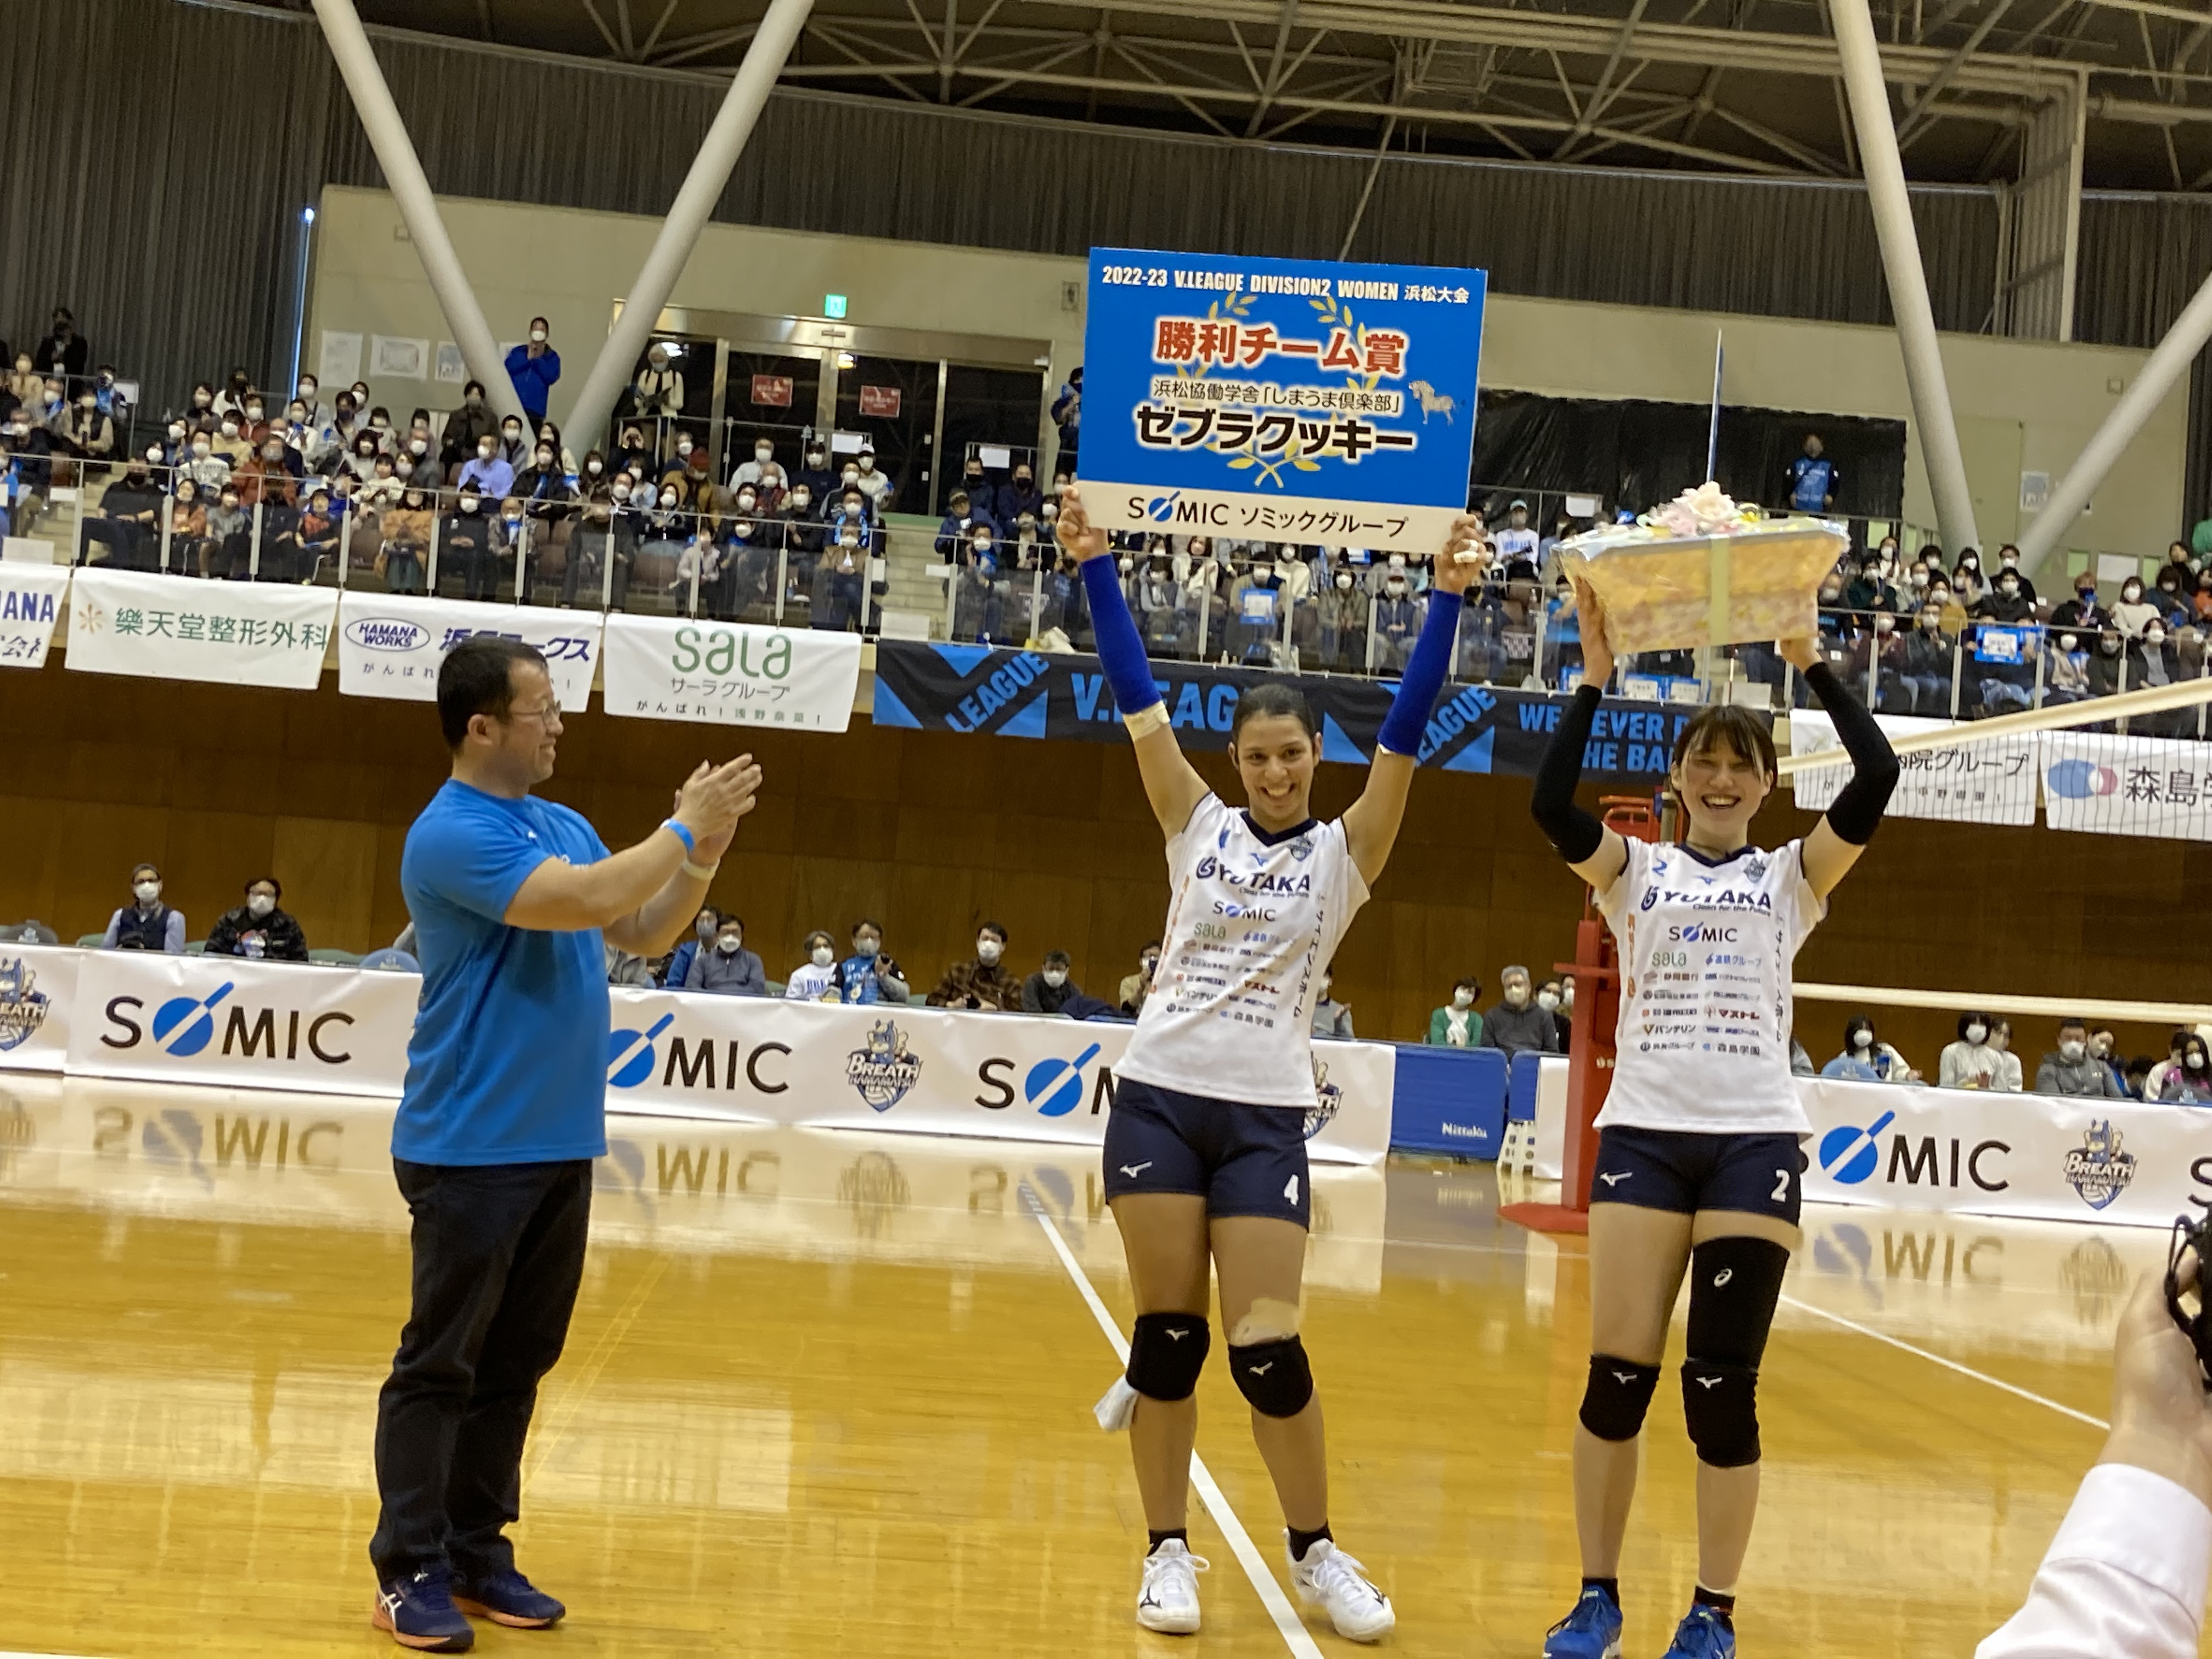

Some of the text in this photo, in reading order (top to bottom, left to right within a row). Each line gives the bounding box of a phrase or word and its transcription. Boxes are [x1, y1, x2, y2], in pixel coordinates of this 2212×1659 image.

[1103, 266, 1470, 304] 2022-23 V.LEAGUE DIVISION2 WOMEN 浜松大会
[1156, 320, 1405, 374] 勝利チーム賞
[1153, 379, 1400, 414] 浜松協働学舎「しまうま倶楽部」
[1137, 406, 1413, 459] ゼブラクッキー
[1128, 490, 1409, 538] SOMIC ソミックグループ
[2, 591, 53, 623] ANA
[115, 607, 328, 651] 樂天堂整形外科
[359, 623, 417, 639] HAMANA
[364, 633, 412, 647] WORKS
[670, 677, 791, 703] サーラグループ
[944, 650, 1049, 732] LEAGUE
[1417, 685, 1498, 766] EAGUE
[1591, 710, 1664, 742] EVER
[1582, 741, 1673, 774] HE BA
[2125, 766, 2212, 807] 森島
[1669, 922, 1737, 943] SOMIC
[100, 981, 355, 1064] SOMIC
[607, 1013, 792, 1094] OMIC
[846, 1053, 922, 1080] BREATH
[1442, 1120, 1487, 1139] Nittaku
[1801, 1110, 2011, 1192] OMIC
[2063, 1152, 2138, 1177] BREATH
[1284, 1173, 1300, 1206] 4
[1771, 1169, 1790, 1203] 2
